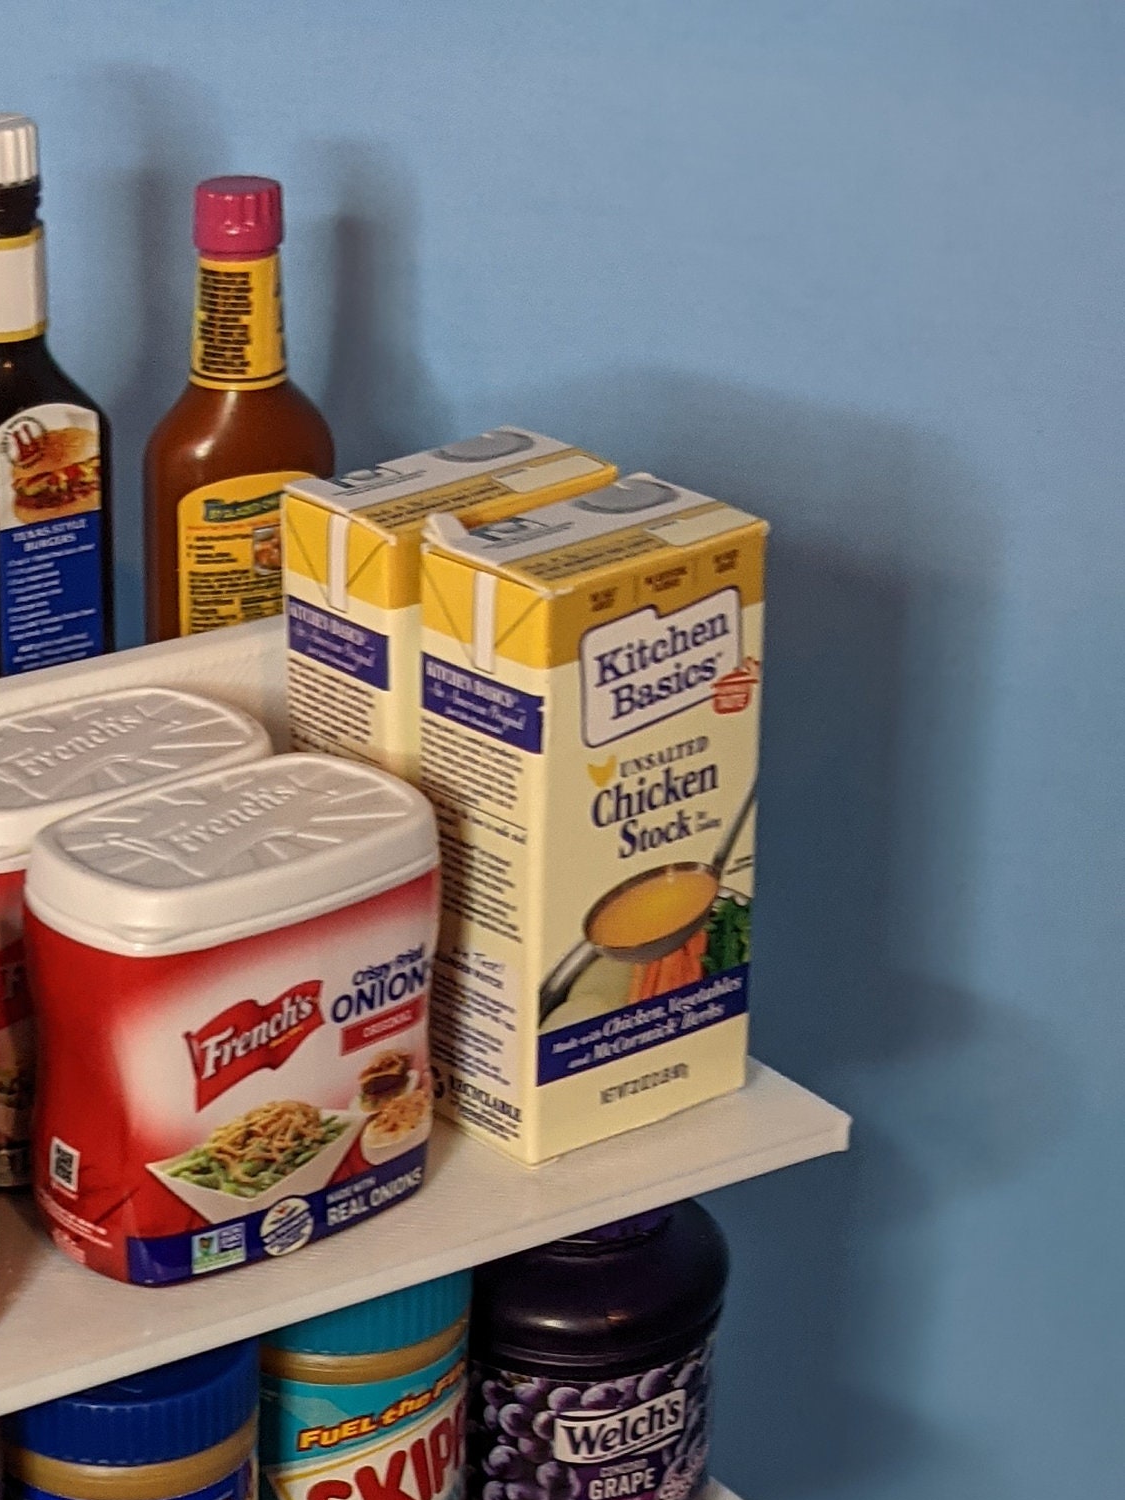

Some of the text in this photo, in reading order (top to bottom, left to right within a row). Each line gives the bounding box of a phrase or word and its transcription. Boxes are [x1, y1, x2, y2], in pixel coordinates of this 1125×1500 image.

[594, 613, 729, 687] Kitchen
[610, 656, 717, 720] Basics
[592, 764, 718, 828] Chicken
[618, 809, 692, 858] Stock
[200, 993, 313, 1081] French's
[327, 1197, 369, 1226] REAL
[561, 1399, 681, 1456] Welch's
[589, 1467, 655, 1500] GRAPE
